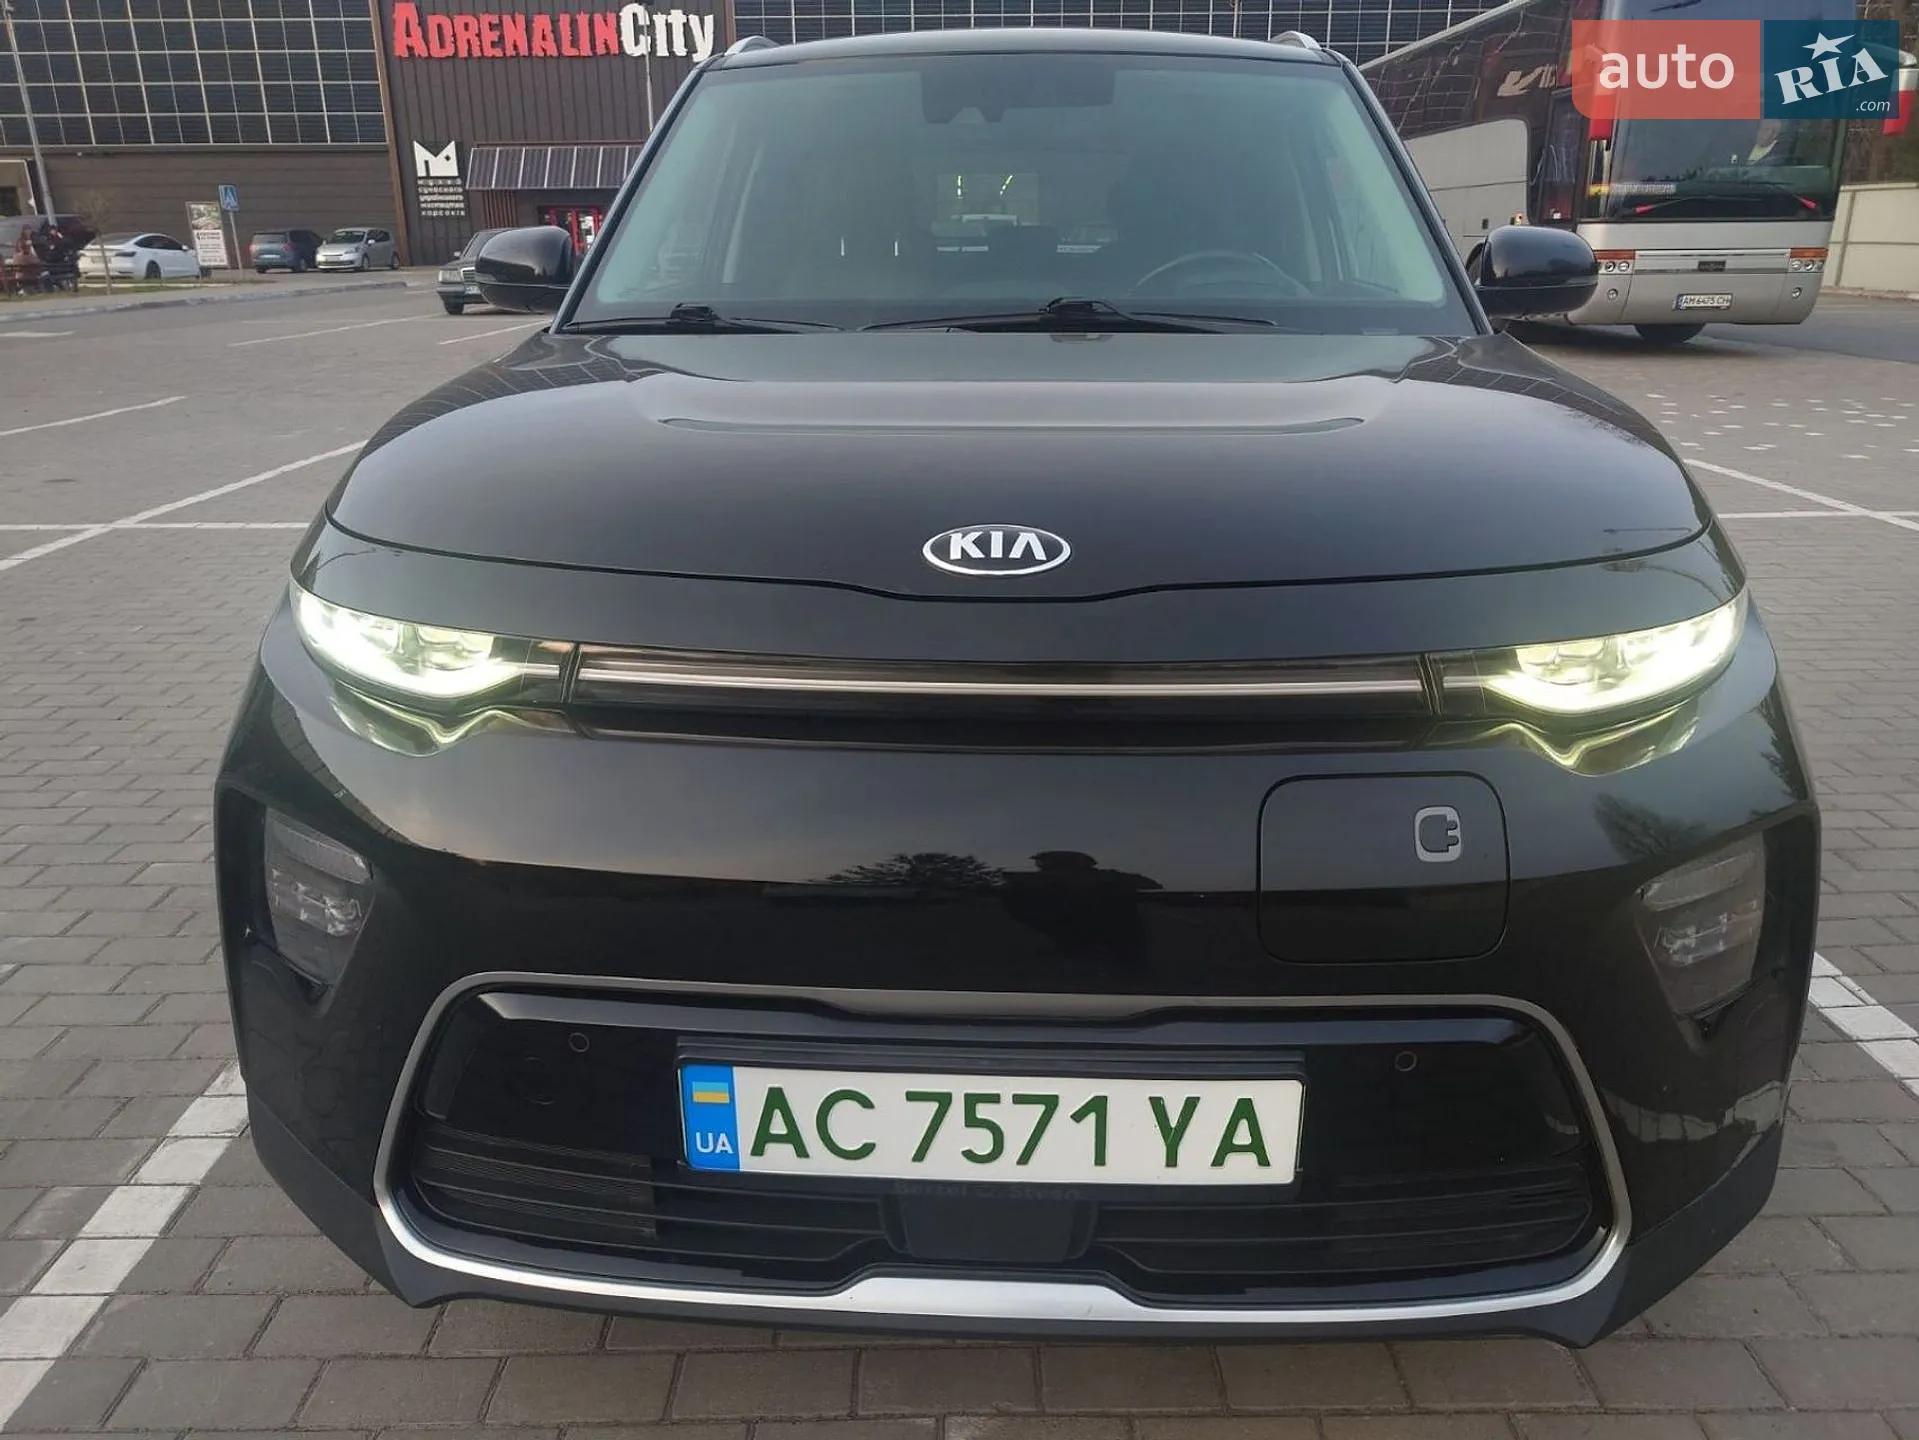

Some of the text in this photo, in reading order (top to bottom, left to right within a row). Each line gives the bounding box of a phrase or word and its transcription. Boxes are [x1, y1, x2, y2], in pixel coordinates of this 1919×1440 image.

[948, 531, 1047, 561] KIA
[750, 1086, 1271, 1169] AC 7571 YA
[695, 1131, 734, 1155] UA
